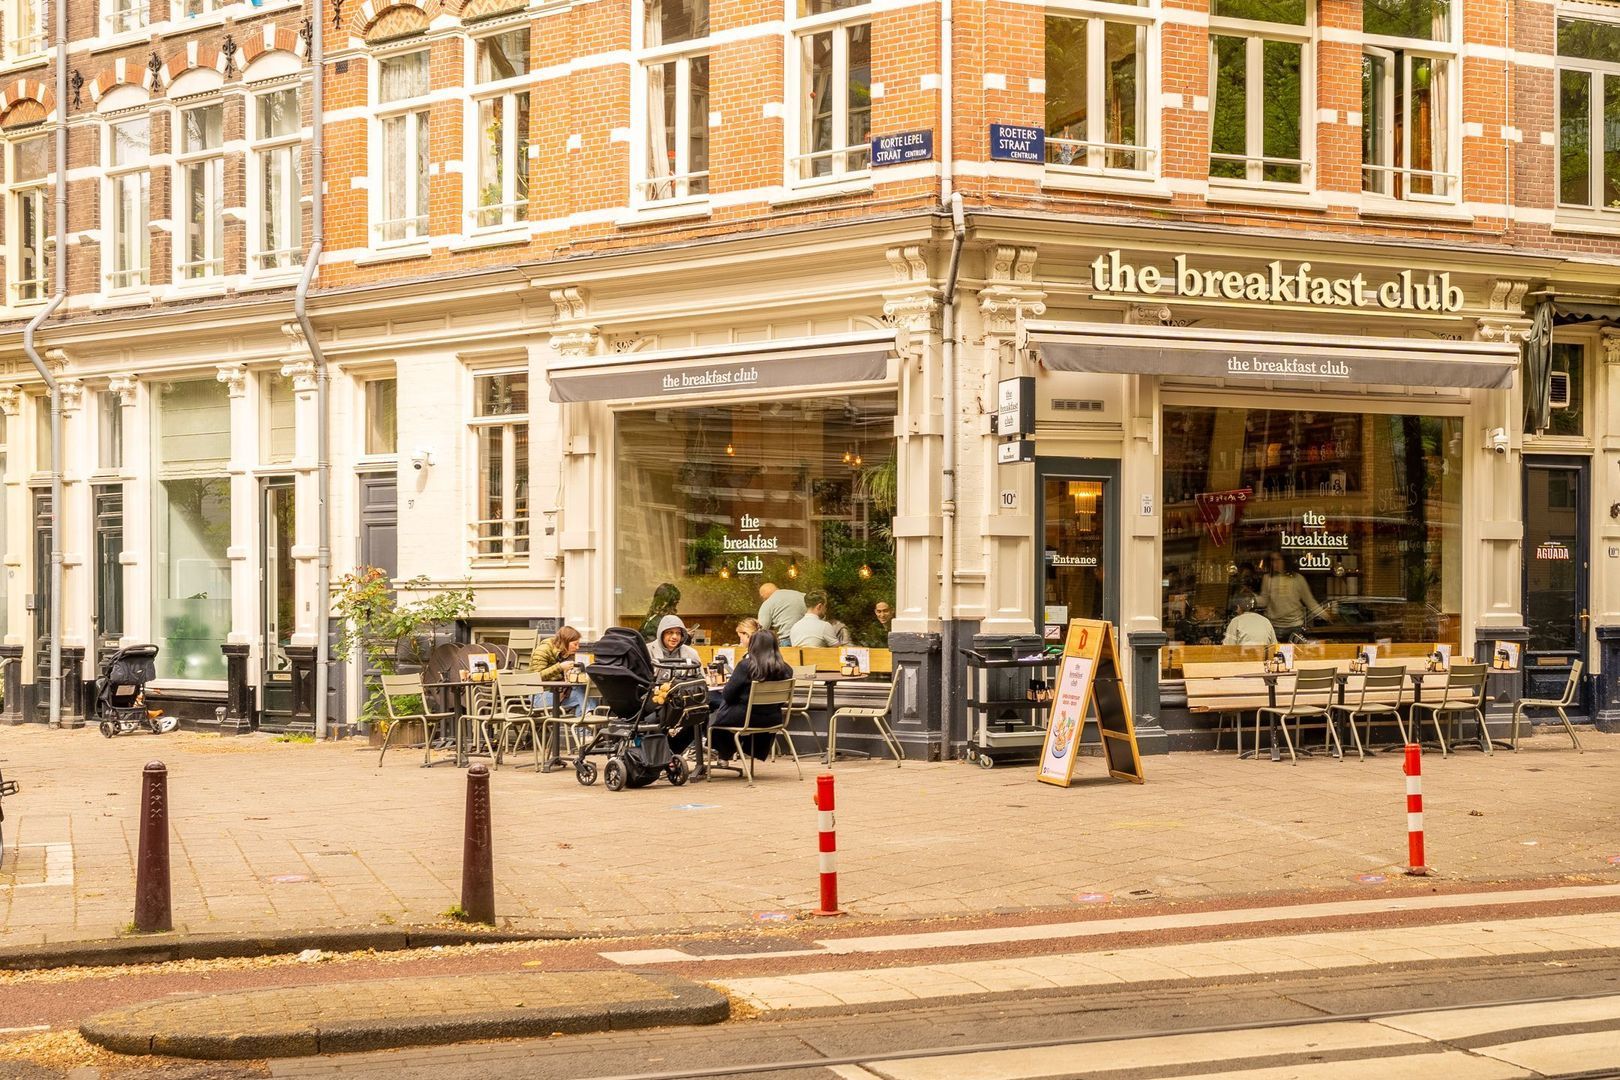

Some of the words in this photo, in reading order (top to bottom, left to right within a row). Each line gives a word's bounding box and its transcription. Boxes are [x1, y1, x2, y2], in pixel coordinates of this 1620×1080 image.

[1000, 127, 1037, 140] ROETERS
[880, 136, 903, 150] KORTE
[904, 133, 924, 146] LEPEL
[999, 139, 1031, 151] STRAAT
[876, 149, 902, 162] STRAAT
[904, 149, 927, 159] CENTRUM
[1010, 151, 1038, 160] CENTRUM
[1091, 250, 1162, 294] the
[1173, 254, 1368, 308] breakfast
[1378, 269, 1465, 313] club
[1227, 356, 1250, 372] the
[1253, 357, 1317, 374] breakfast
[1319, 360, 1349, 375] club
[662, 374, 680, 388] the
[682, 369, 732, 386] breakfast
[733, 366, 758, 382] club
[740, 513, 760, 528] the
[1302, 510, 1326, 525] the
[723, 533, 778, 549] breakfast
[1281, 531, 1349, 546] breakfast
[1052, 554, 1097, 565] Entrance
[1299, 552, 1331, 567] club
[1536, 547, 1569, 560] AGUADA
[737, 555, 764, 571] club
